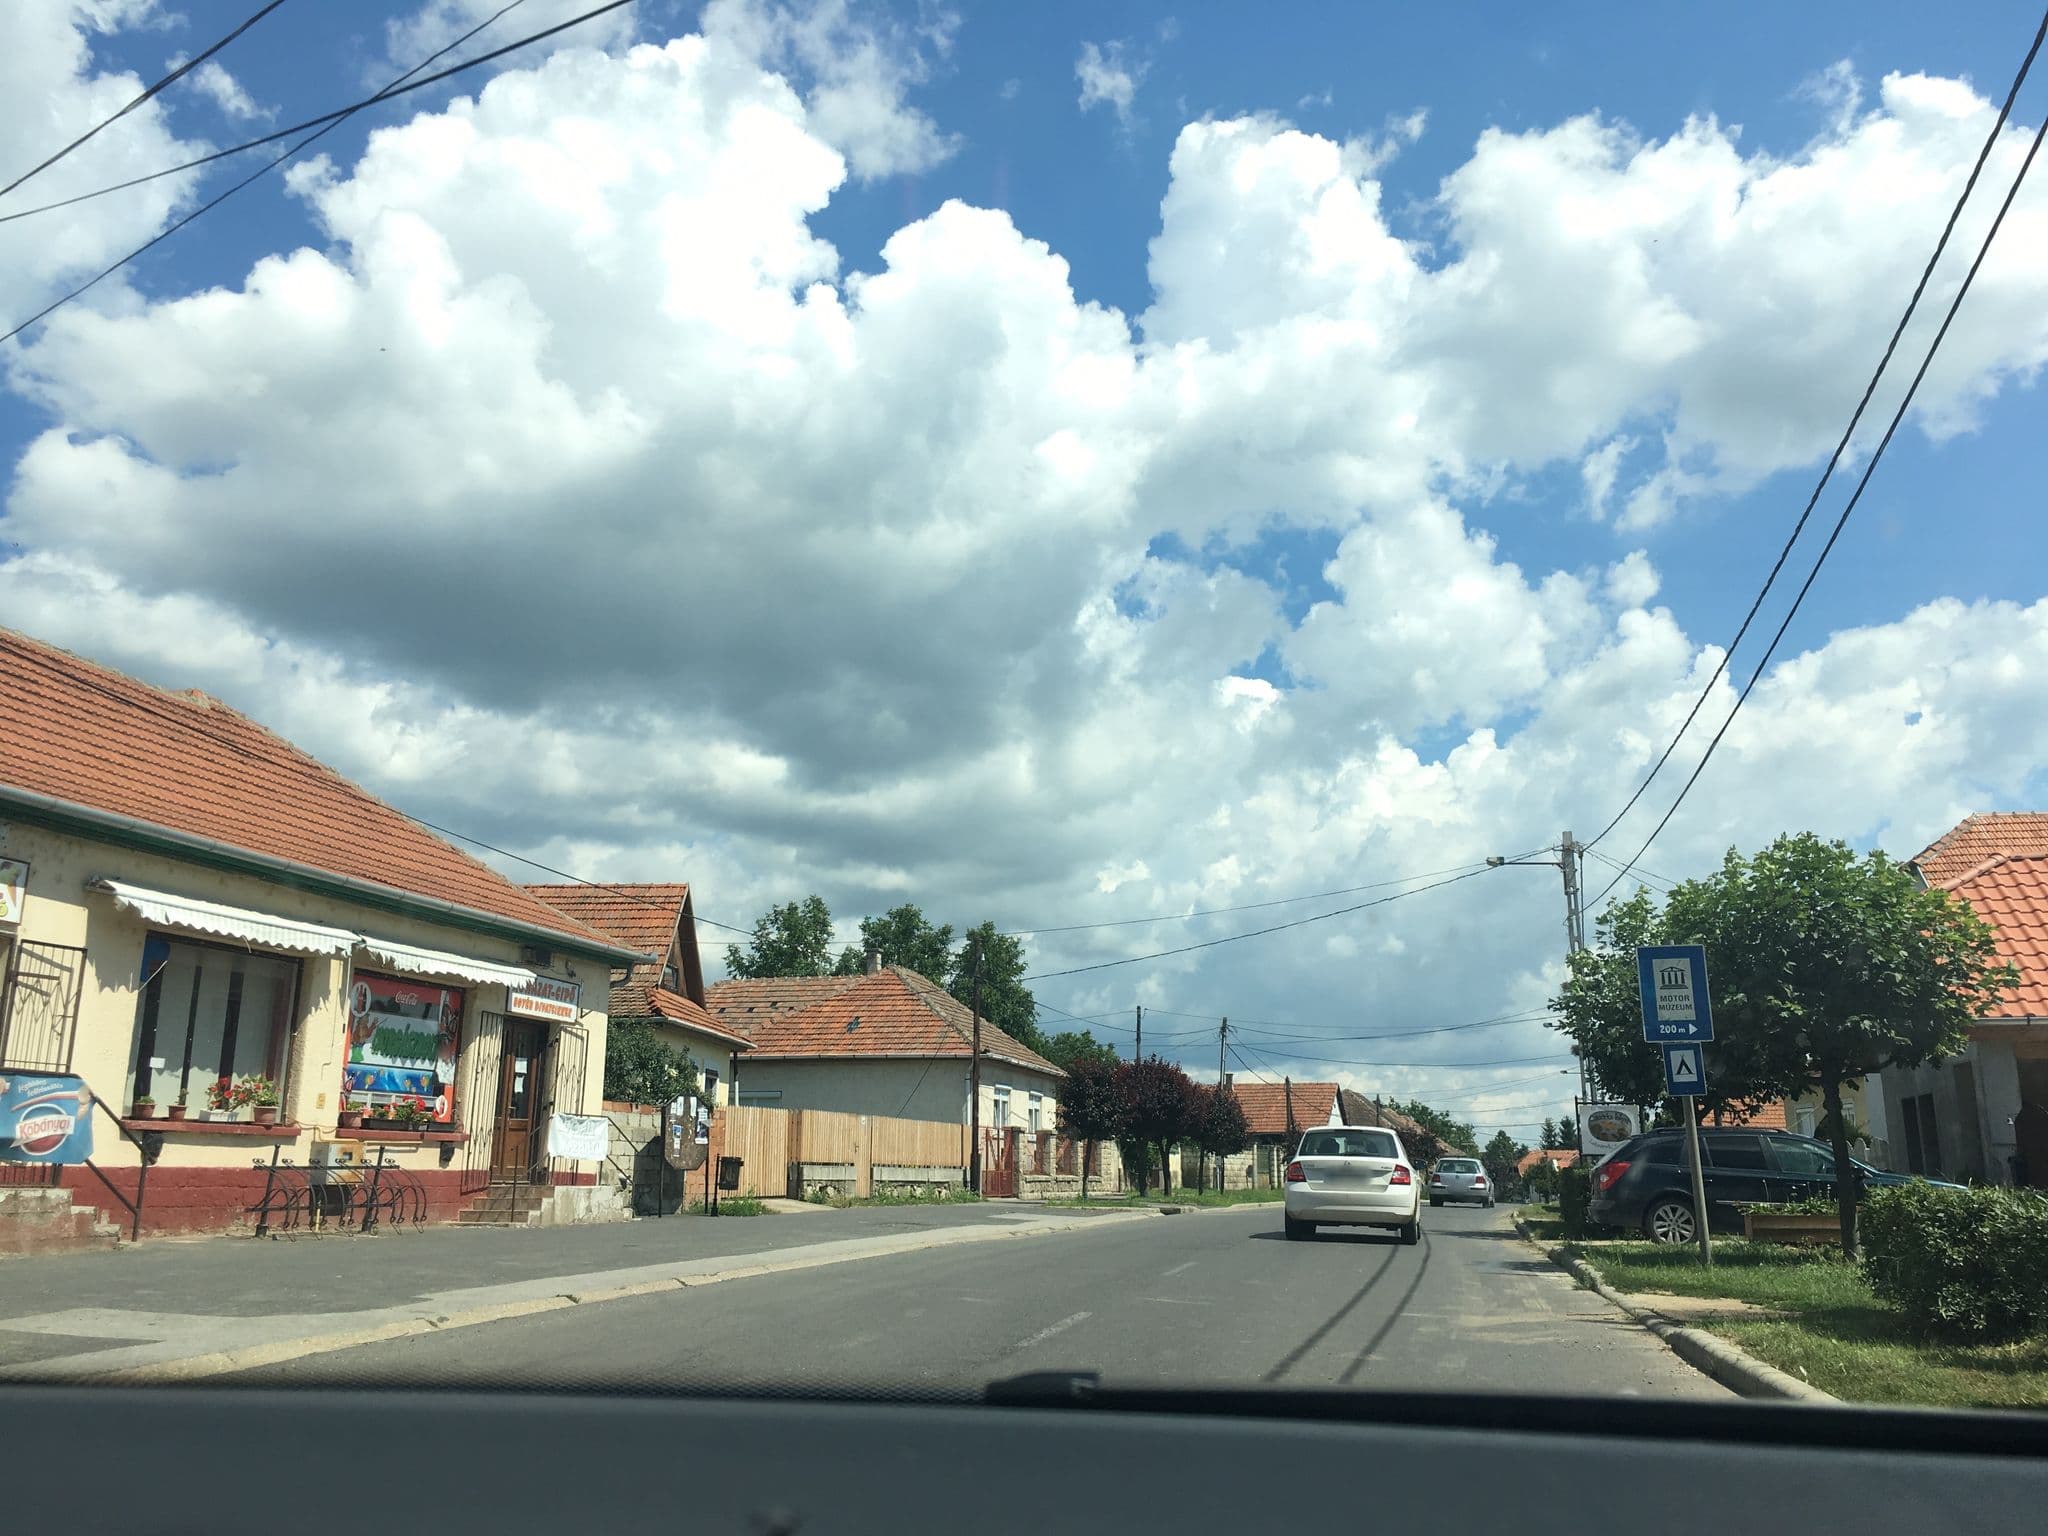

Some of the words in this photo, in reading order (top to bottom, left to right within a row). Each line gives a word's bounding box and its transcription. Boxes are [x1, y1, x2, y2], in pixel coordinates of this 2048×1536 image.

[1660, 994, 1690, 1003] MOTOR
[1659, 1002, 1692, 1011] MÚZEUM
[1659, 1024, 1677, 1034] 200
